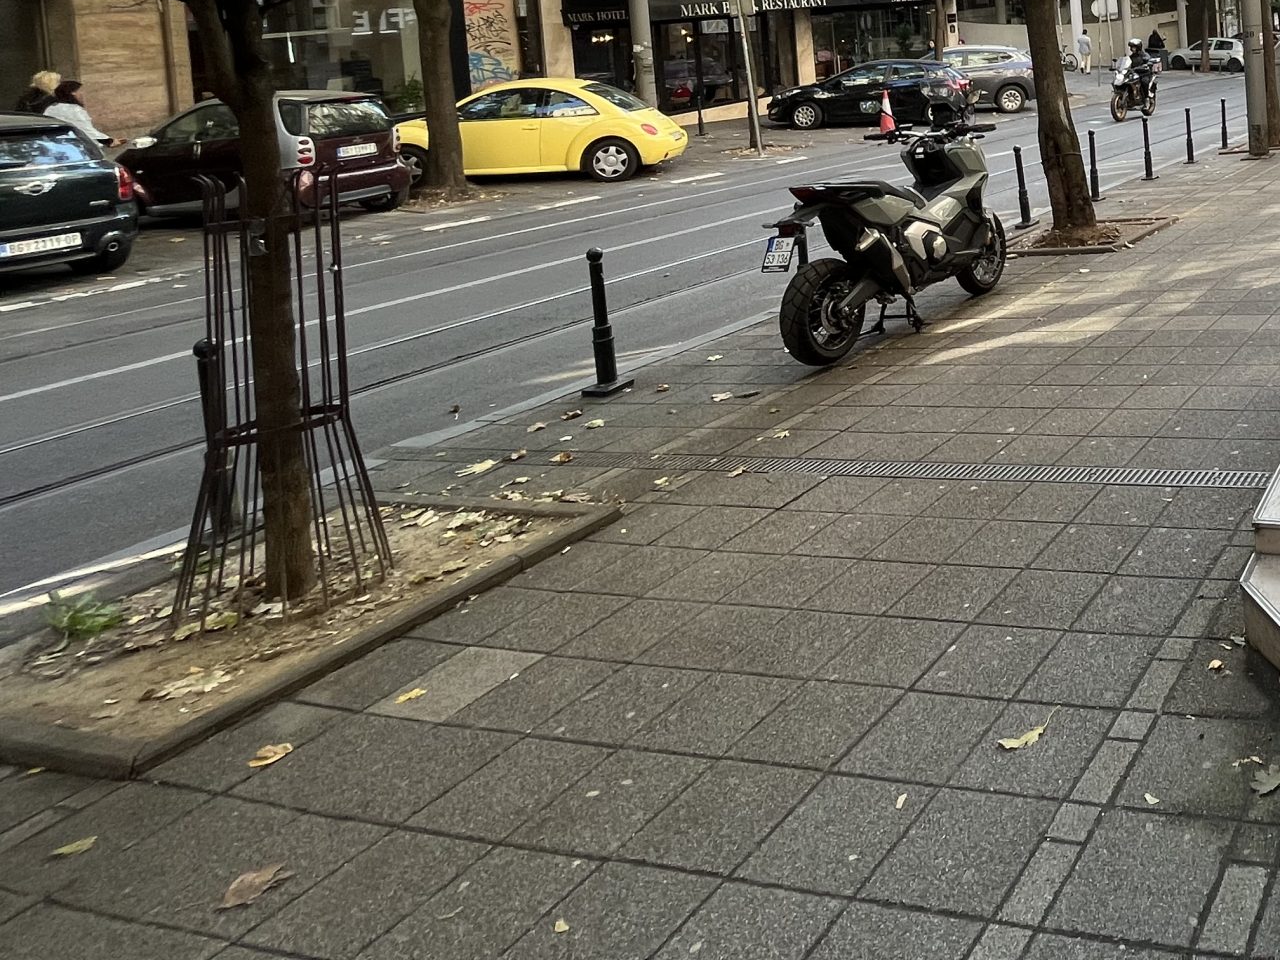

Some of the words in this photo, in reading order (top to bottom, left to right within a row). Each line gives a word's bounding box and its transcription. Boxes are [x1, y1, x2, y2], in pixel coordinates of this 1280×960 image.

[680, 1, 719, 18] MARK
[567, 12, 595, 23] MARK
[596, 9, 629, 21] HOTEL
[775, 240, 784, 250] BG
[766, 254, 775, 264] 53
